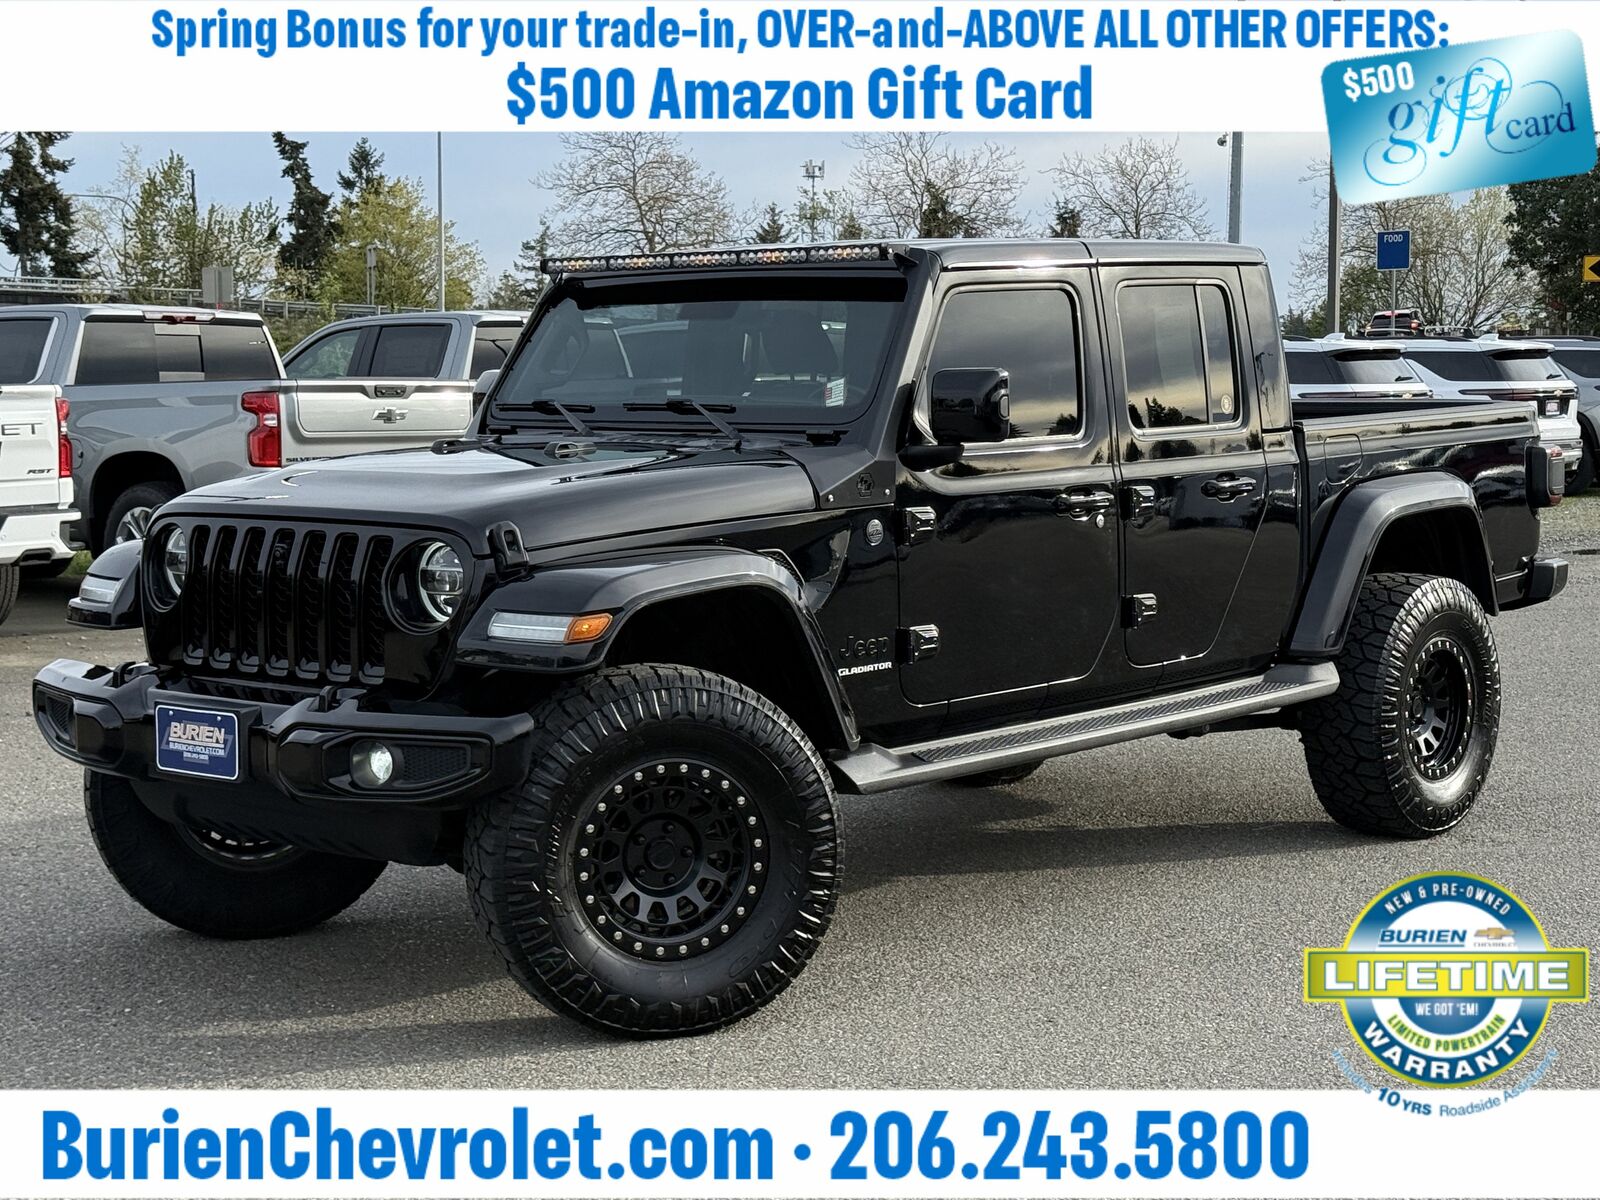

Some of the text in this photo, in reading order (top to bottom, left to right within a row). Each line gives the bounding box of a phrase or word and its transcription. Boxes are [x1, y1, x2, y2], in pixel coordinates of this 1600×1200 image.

[1384, 234, 1403, 243] FOOD
[1, 423, 43, 436] ET
[838, 661, 892, 677] GLADIATOR
[170, 721, 225, 744] BURIEN
